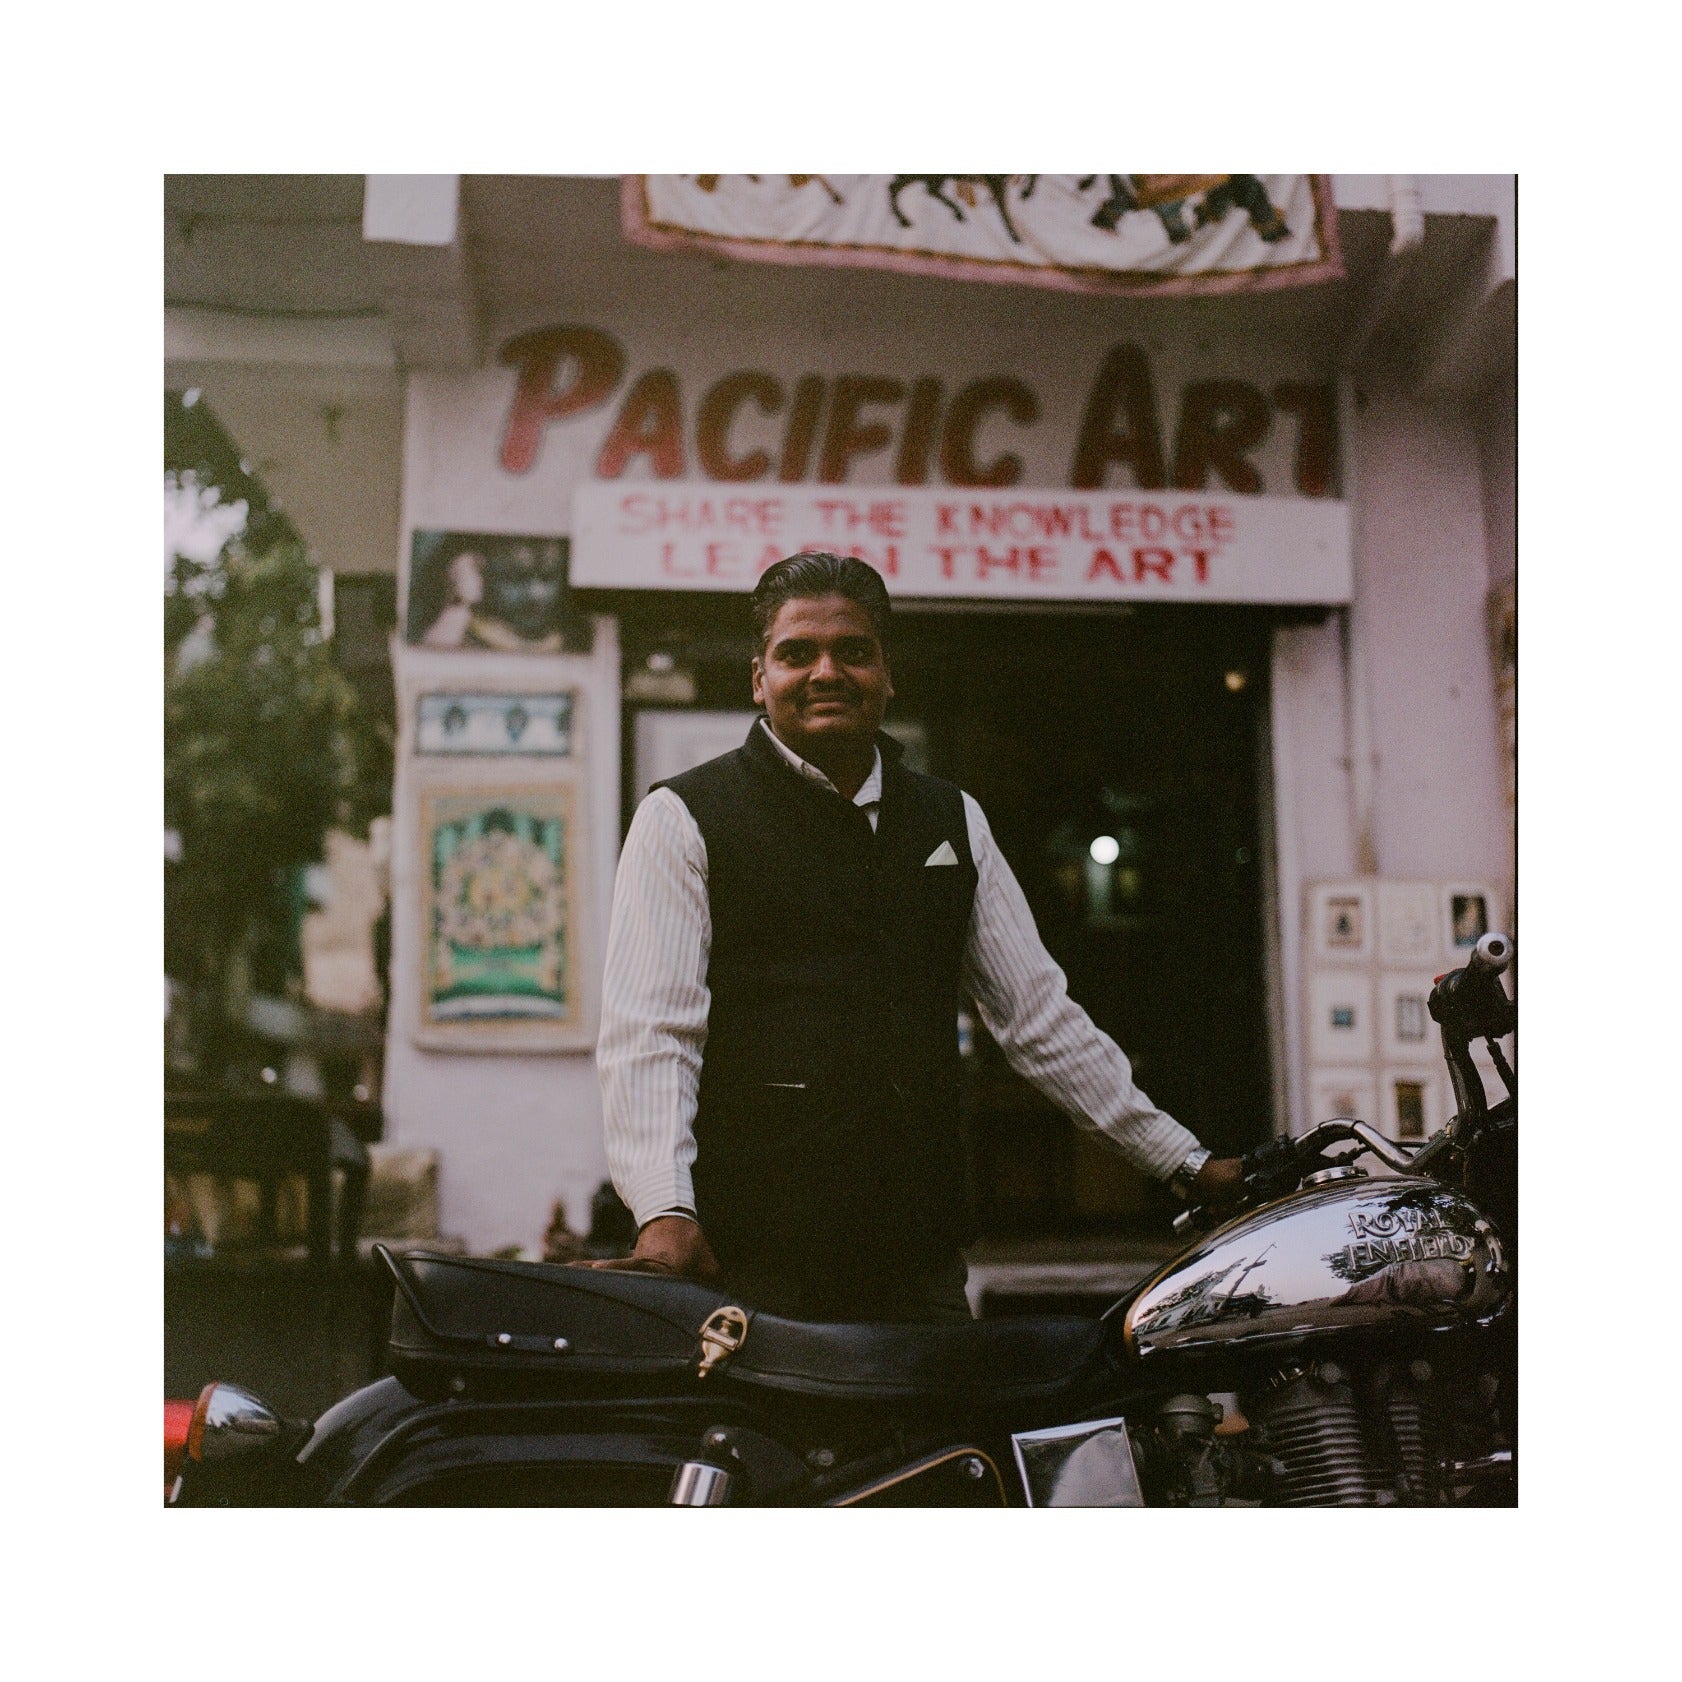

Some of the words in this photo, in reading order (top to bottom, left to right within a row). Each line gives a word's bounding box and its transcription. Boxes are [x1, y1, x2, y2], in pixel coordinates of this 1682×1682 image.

[500, 323, 1041, 489] PACIFIC
[1070, 341, 1343, 497] ART
[620, 494, 784, 538] SHARE
[817, 499, 906, 539] THE
[935, 501, 1237, 543] KNOWLEDGE
[929, 545, 1058, 582] THE
[1085, 547, 1223, 586] ART
[1347, 1208, 1453, 1239] ROYAL
[1349, 1232, 1476, 1270] ENFIELD
